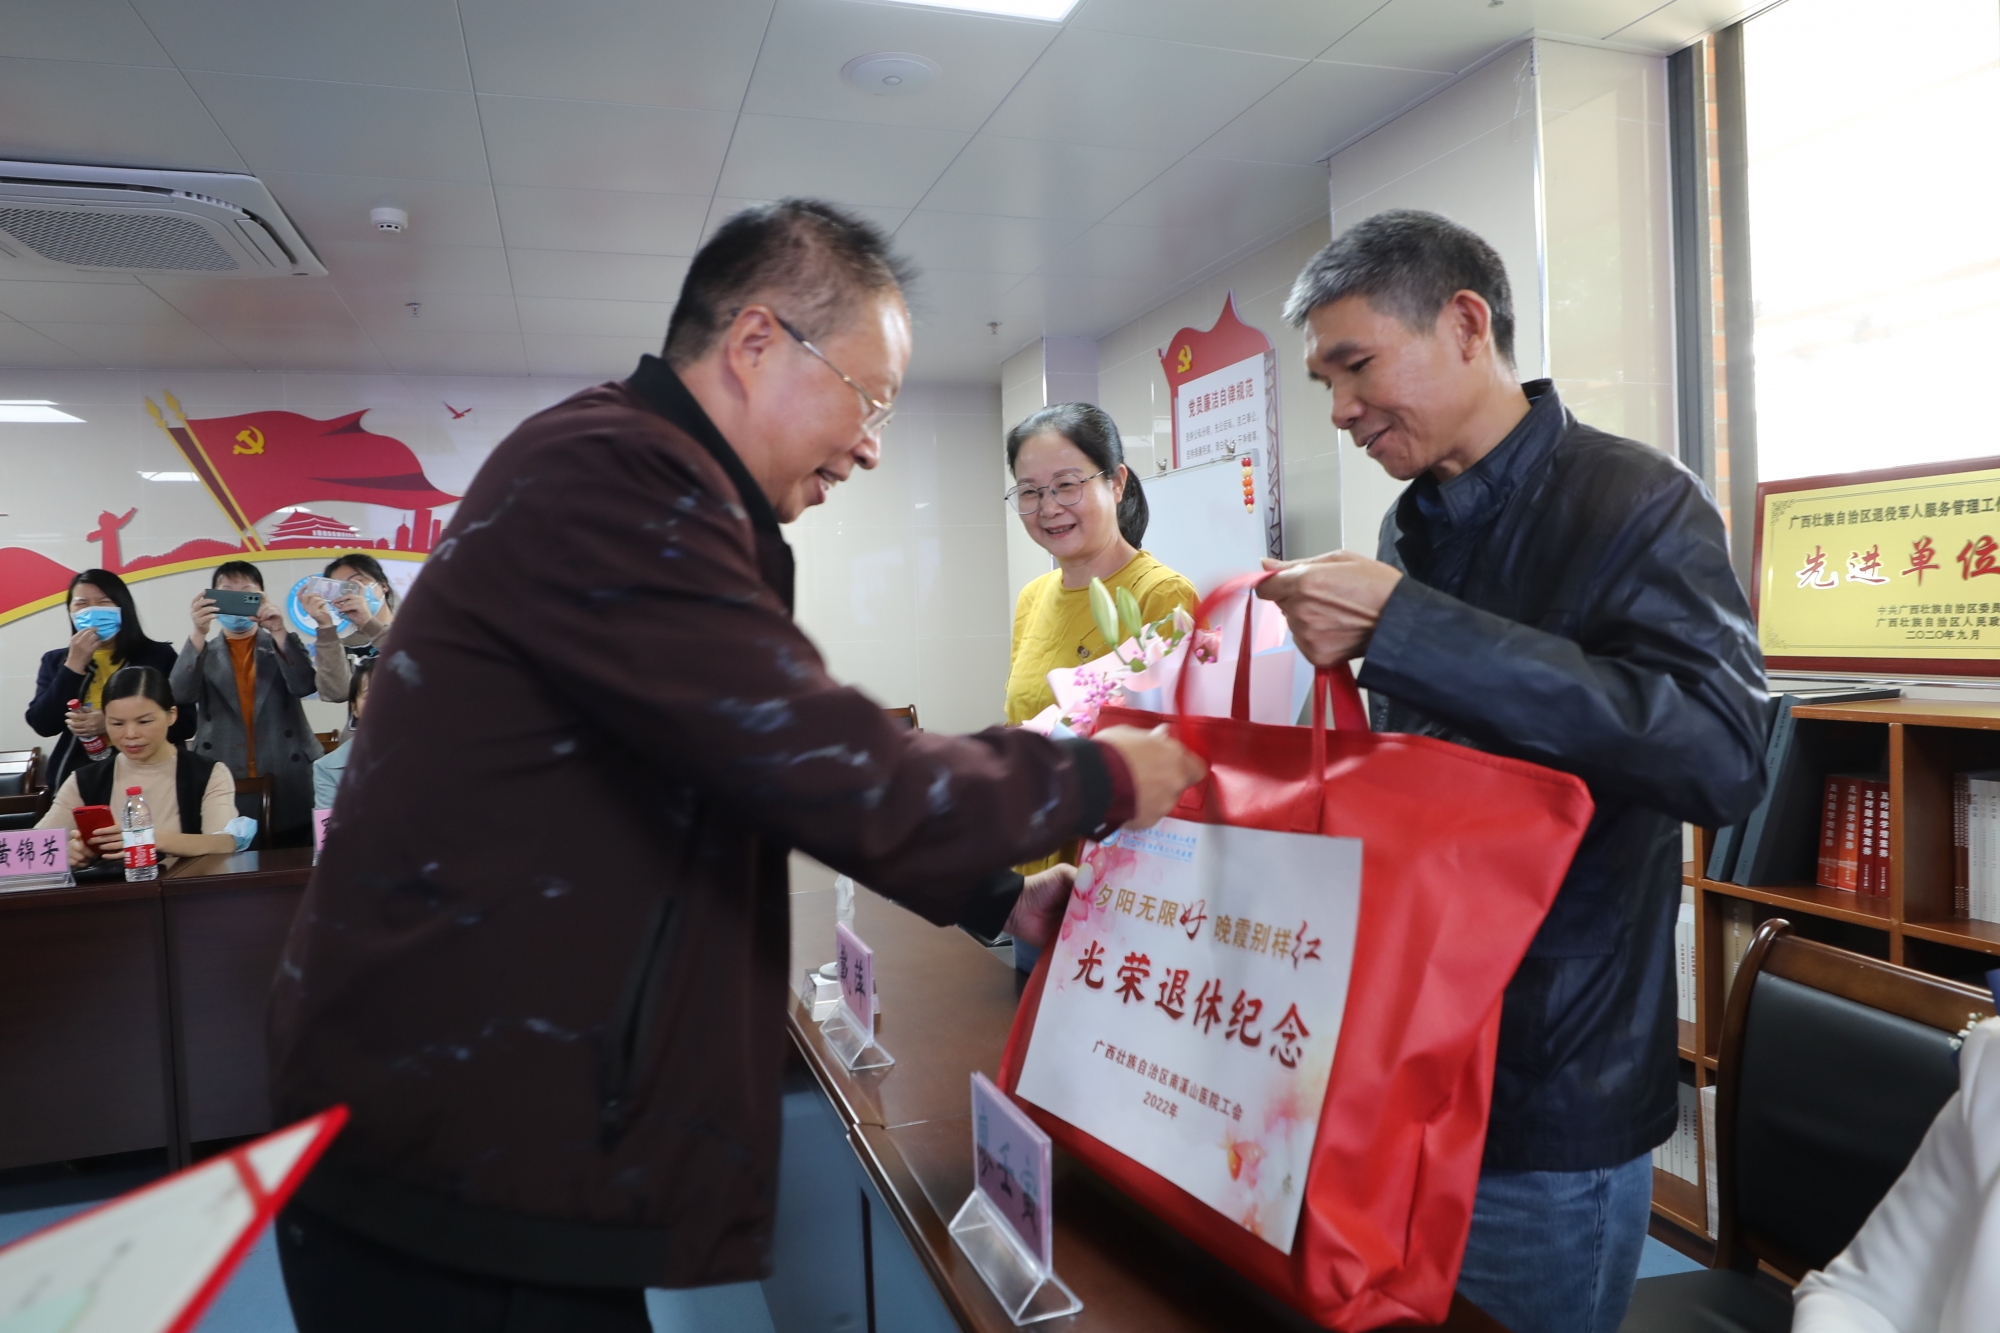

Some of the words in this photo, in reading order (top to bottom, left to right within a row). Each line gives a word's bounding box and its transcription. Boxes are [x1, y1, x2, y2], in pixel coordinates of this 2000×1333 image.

[1800, 534, 2000, 588] 先进单位
[1095, 883, 1208, 940] 夕阳无限好
[1213, 914, 1323, 971] 晚霞别样红
[1072, 940, 1311, 1070] 光荣退休纪念
[1092, 1040, 1244, 1123] 广西壮族自治区南溪山医院工会
[1143, 1091, 1179, 1120] 2022年
